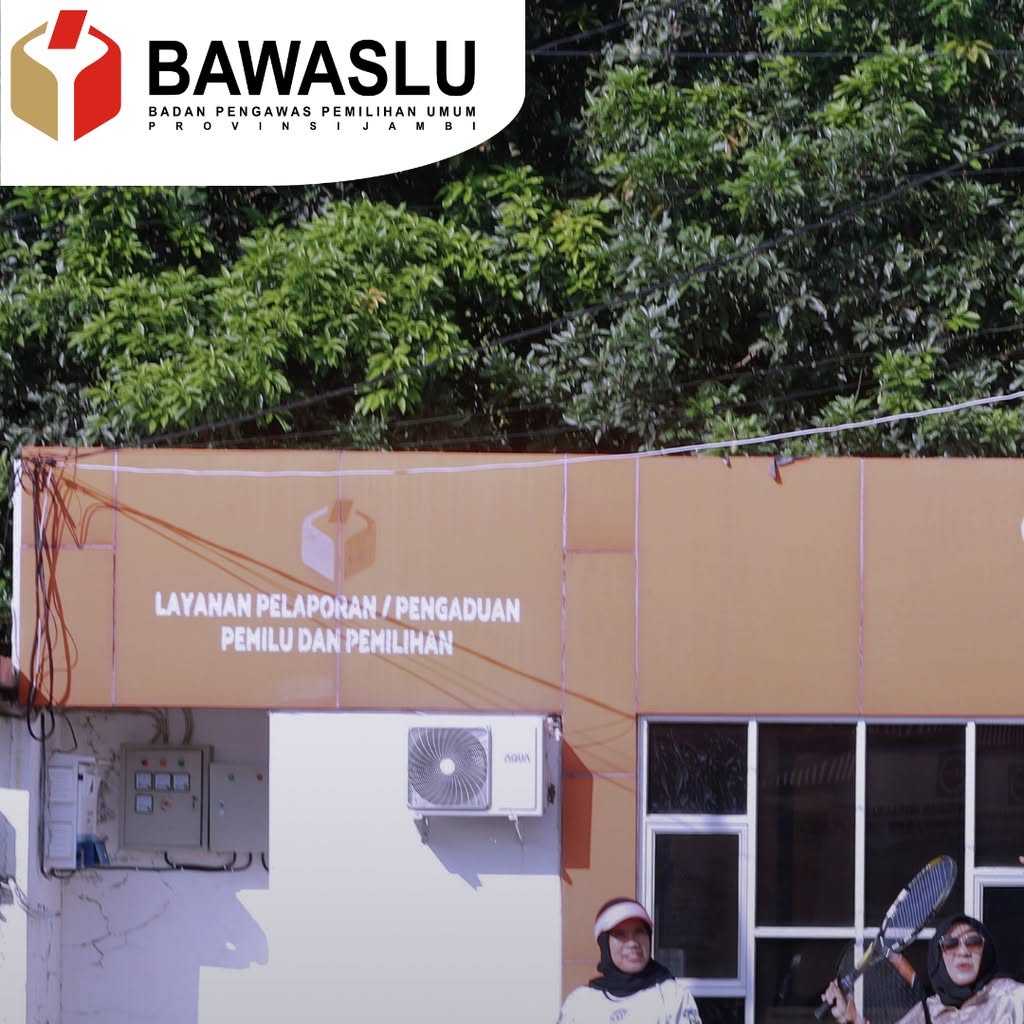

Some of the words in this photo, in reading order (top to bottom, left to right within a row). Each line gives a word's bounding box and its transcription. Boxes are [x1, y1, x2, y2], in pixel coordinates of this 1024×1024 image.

[155, 591, 251, 616] LAYANAN
[256, 593, 377, 619] PELAPORAN
[382, 594, 392, 618] /
[395, 596, 520, 622] PENGADUAN
[221, 626, 293, 652] PEMILU
[298, 627, 341, 653] DAN
[345, 628, 453, 655] PEMILIHAN
[504, 753, 530, 764] AQUA
